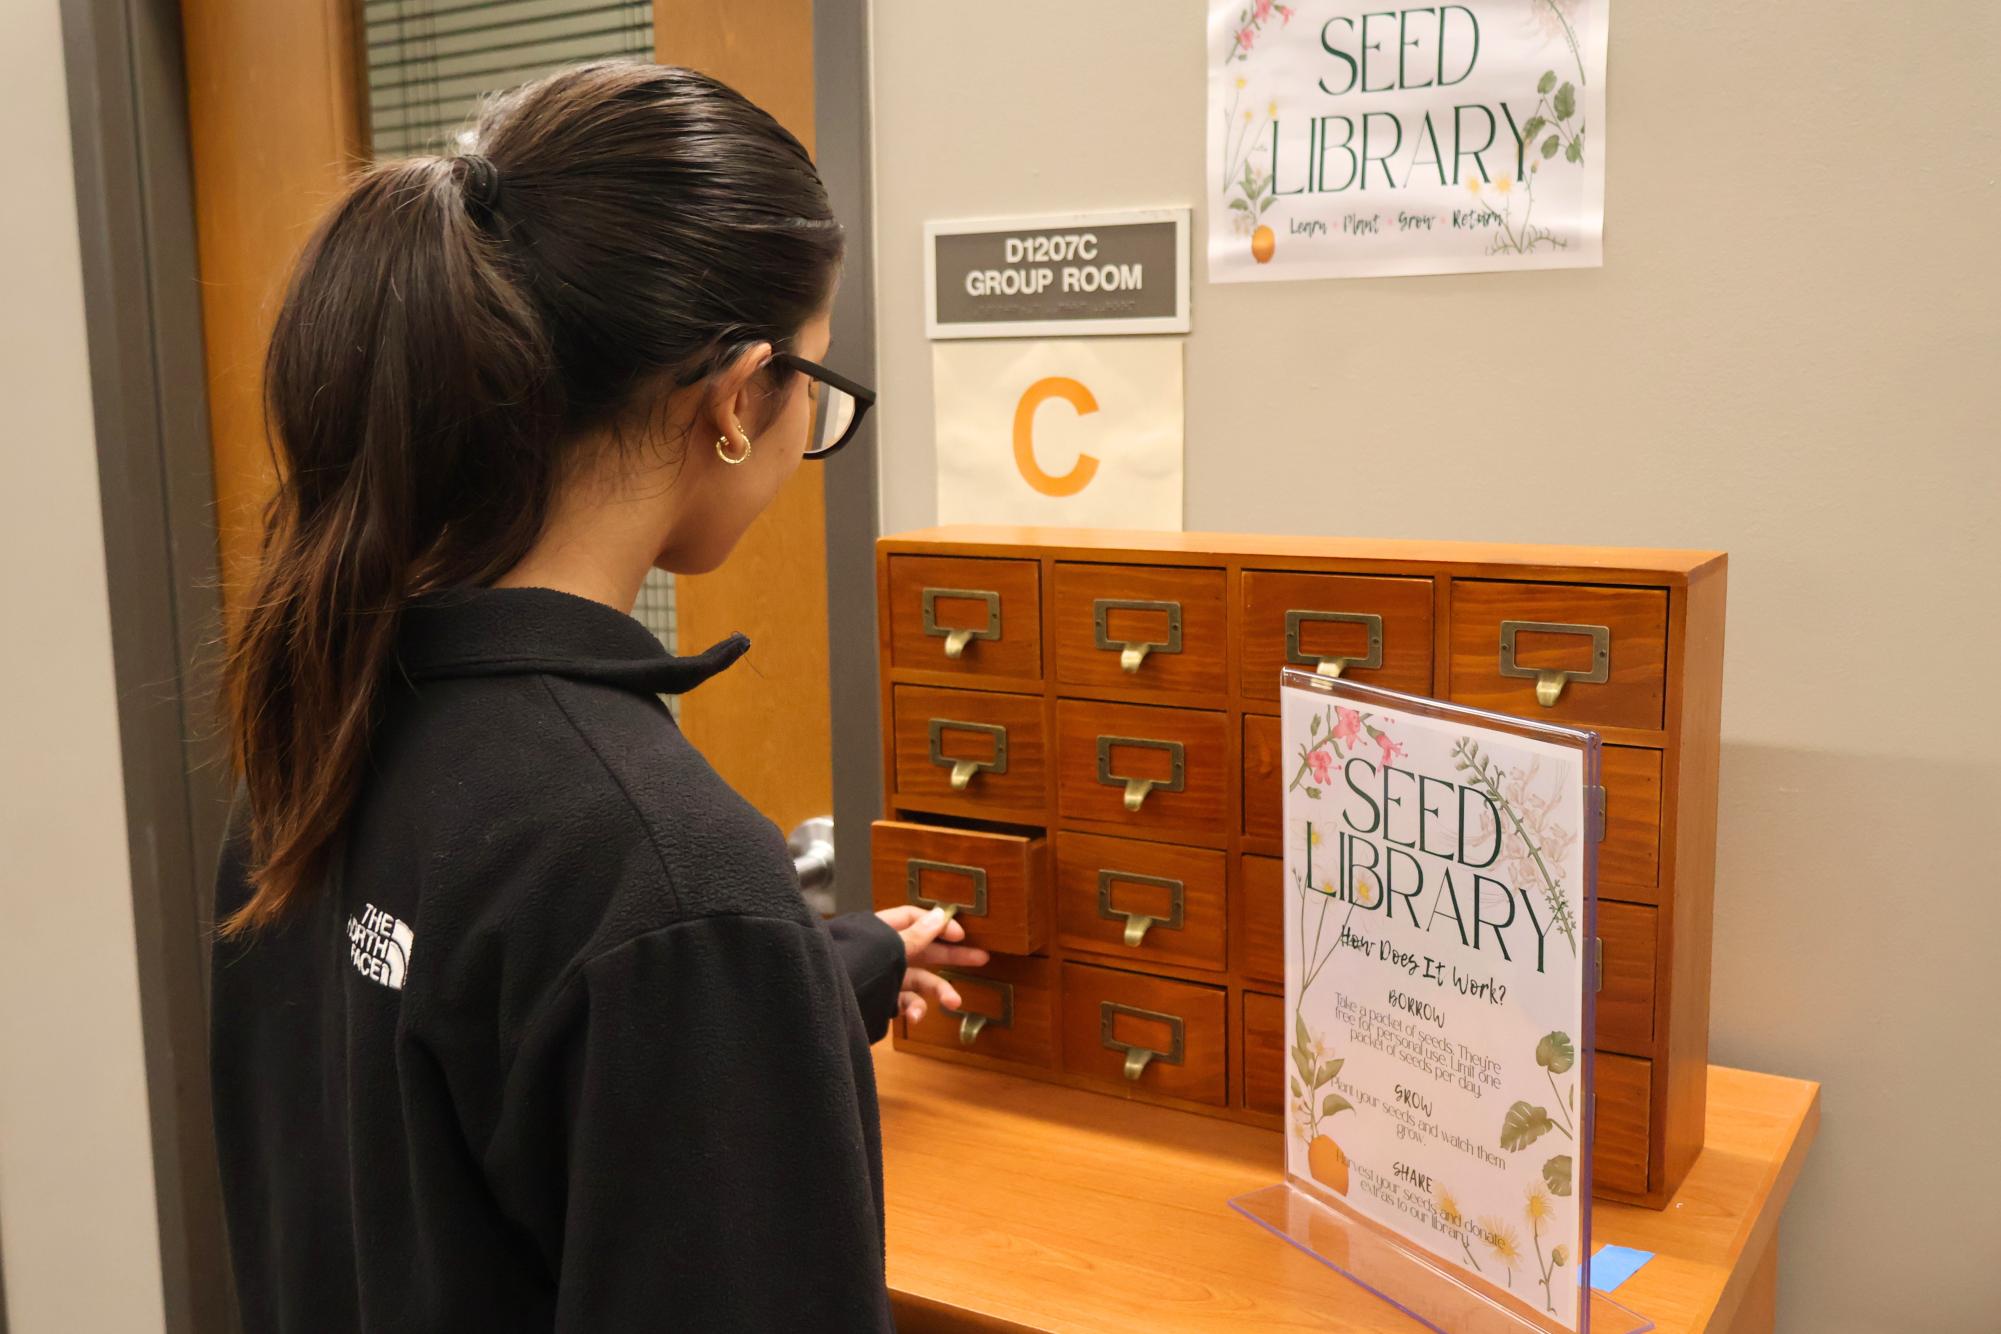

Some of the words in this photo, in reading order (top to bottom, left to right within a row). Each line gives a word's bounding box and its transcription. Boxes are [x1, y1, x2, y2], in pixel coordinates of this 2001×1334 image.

[1319, 5, 1480, 96] SEED
[1271, 101, 1543, 196] LIBRARY
[1289, 217, 1327, 238] Learn
[1343, 213, 1380, 235] Plant
[1398, 211, 1436, 230] Grow
[1452, 208, 1504, 229] Return
[1005, 234, 1098, 263] D1207C
[965, 269, 1053, 296] GROUP
[1062, 264, 1142, 292] ROOM
[1013, 376, 1100, 497] C
[1342, 757, 1502, 868] SEED
[361, 903, 395, 938] THE
[1306, 820, 1565, 974] LIBRARY
[346, 914, 390, 959] NORTH
[351, 943, 383, 981] FACE
[1341, 925, 1376, 957] How
[1379, 939, 1420, 975] Does
[1422, 956, 1446, 986] It
[1452, 965, 1507, 1005] Work?
[1334, 991, 1358, 1013] Take
[1359, 1006, 1367, 1017] a
[1368, 1009, 1402, 1032] packet
[1405, 1024, 1417, 1038] of
[1388, 989, 1445, 1028] BORROW
[1335, 1005, 1357, 1026] free
[1376, 1026, 1423, 1056] personal
[1478, 1071, 1502, 1090] one
[1350, 1028, 1384, 1051] packet
[1386, 1043, 1397, 1057] of
[1399, 1050, 1433, 1074] seeds
[1435, 1066, 1455, 1084] per
[1394, 1083, 1433, 1118] GROW
[1356, 1089, 1380, 1108] your
[1382, 1102, 1416, 1127] seeds
[1417, 1119, 1438, 1138] and
[1441, 1129, 1474, 1156] watch
[1476, 1144, 1506, 1171] them
[1392, 1161, 1433, 1194] SHARE
[1376, 1175, 1400, 1195] your
[1403, 1188, 1437, 1216] seeds
[1440, 1208, 1462, 1228] and
[1464, 1219, 1506, 1250] donate
[1396, 1197, 1408, 1213] to
[1409, 1206, 1430, 1224] our
